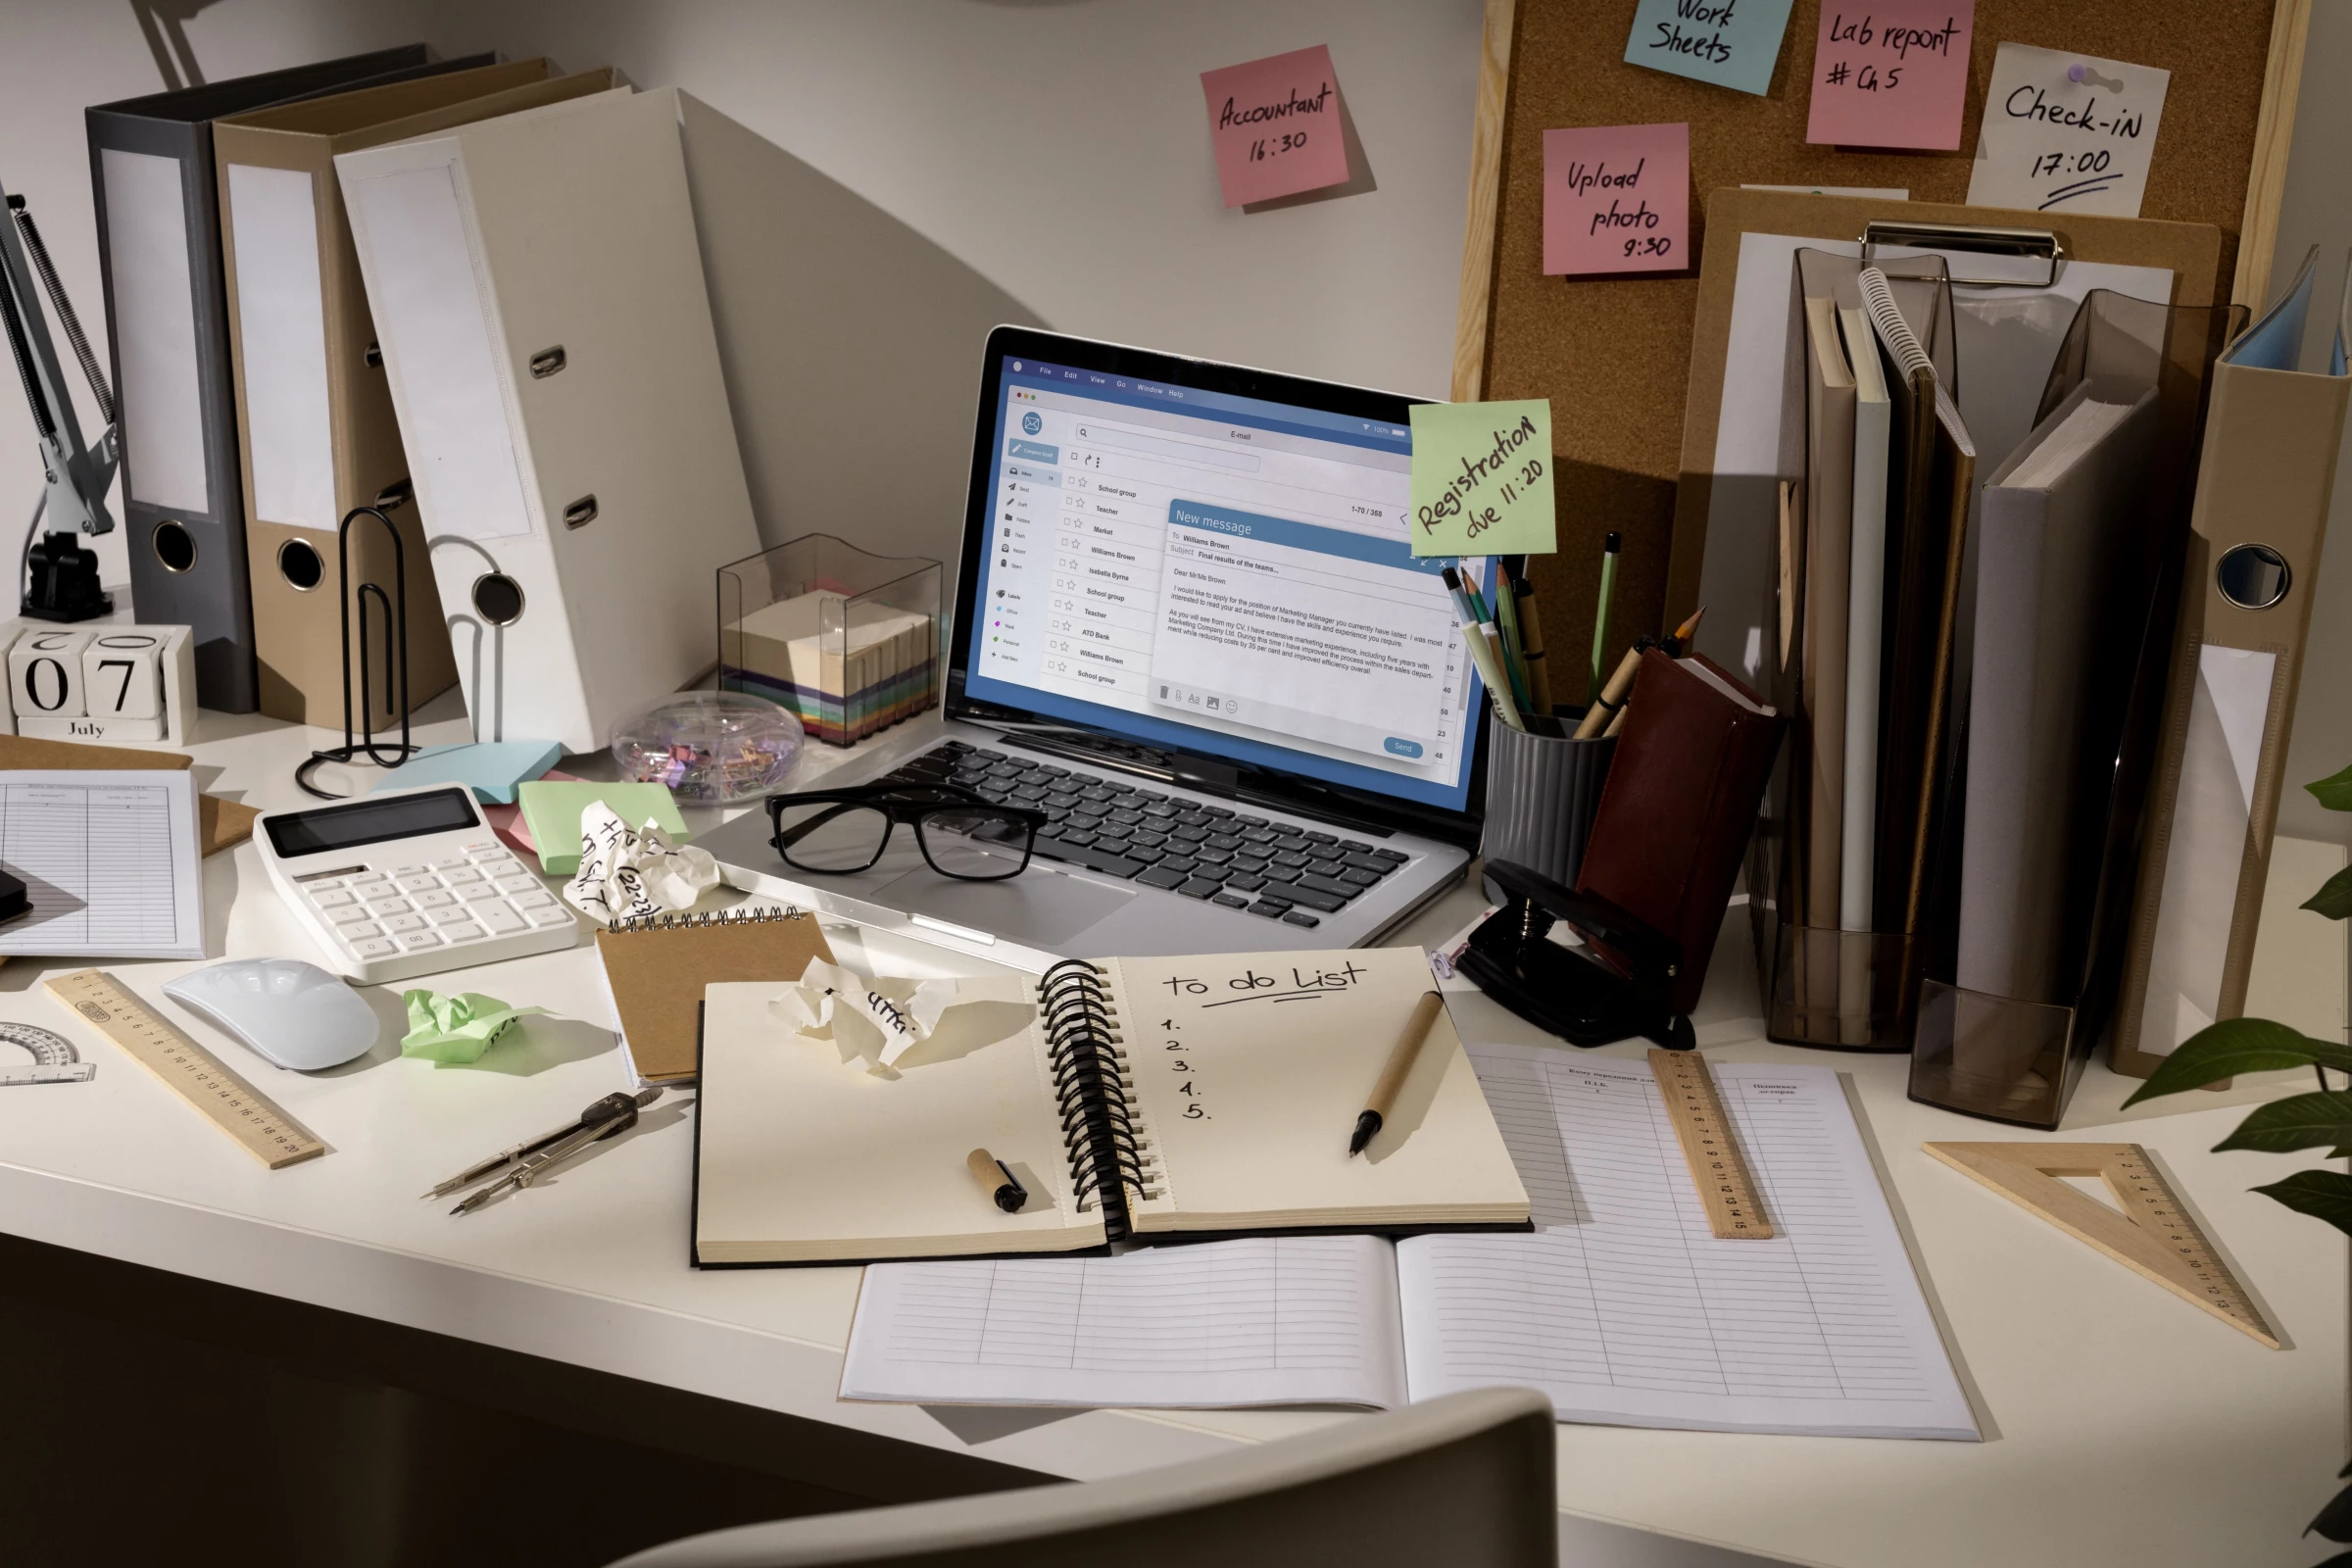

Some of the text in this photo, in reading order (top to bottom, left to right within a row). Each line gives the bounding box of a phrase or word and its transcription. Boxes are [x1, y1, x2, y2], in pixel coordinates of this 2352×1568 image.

[1677, 0, 1735, 27] Work
[1649, 23, 1733, 63] Sheets
[1831, 14, 1961, 61] Lab report
[1219, 82, 1333, 130] Accountant
[1250, 131, 1307, 163] 16:30
[2032, 150, 2110, 178] 17:00
[1568, 158, 1644, 196] Upload
[1591, 200, 1659, 235] photo
[1624, 237, 1671, 257] 9:30
[1040, 367, 1052, 375] File
[1138, 384, 1163, 394] Window
[1169, 390, 1184, 399] Help
[1231, 431, 1251, 440] E-mail
[1374, 425, 1389, 434] 100%
[1099, 484, 1137, 498] School group
[1467, 460, 1543, 538] due 11:20
[1097, 506, 1119, 515] Teacher
[1371, 509, 1382, 517] 358
[1176, 510, 1251, 536] New message
[1094, 526, 1113, 536] Market
[1183, 535, 1208, 545] Williams
[1209, 541, 1230, 550] Brown
[1092, 547, 1136, 562] Williams Brown
[1170, 545, 1194, 557] Subject
[1198, 551, 1213, 560] Final
[1214, 555, 1235, 564] results
[1254, 564, 1279, 573] teams...
[1090, 567, 1129, 581] Isabella Byrne
[1189, 571, 1207, 580] Mr/Ms
[1207, 575, 1226, 584] Brown
[1087, 588, 1125, 602] School group
[1085, 609, 1107, 619] Teacher
[1177, 586, 1194, 595] would
[1212, 593, 1228, 604] apply
[1249, 601, 1270, 612] position
[1279, 607, 1308, 619] Marketing
[1308, 613, 1335, 625] Manager
[1348, 621, 1374, 633] currently
[1170, 593, 1200, 604] interested
[1255, 611, 1276, 619] believe
[1335, 627, 1367, 640] experience
[1380, 637, 1403, 648] require.
[1082, 629, 1110, 641] ATD Bank
[1235, 623, 1247, 632] CV,
[1266, 629, 1294, 640] extensive
[1294, 635, 1323, 649] marketing
[1324, 642, 1358, 656] experience,
[1359, 650, 1387, 662] including
[1399, 660, 1416, 668] years
[1448, 642, 1457, 651] 47
[1080, 650, 1124, 664] Williams Brown
[1078, 670, 1115, 685] School group
[68, 722, 105, 738] July
[1395, 742, 1412, 754] Send
[1229, 971, 1275, 990] do
[1294, 961, 1367, 988] List
[1160, 1019, 1181, 1030] 1.
[1166, 1041, 1189, 1051] 2.
[1172, 1060, 1196, 1072] 3.
[196, 1073, 208, 1082] 12
[1180, 1082, 1201, 1096] 4.
[1183, 1103, 1211, 1119] 5.
[284, 1145, 299, 1153] 20
[2188, 1259, 2201, 1268] 10
[2207, 1286, 2220, 1295] 12
[2216, 1299, 2230, 1308] 13
